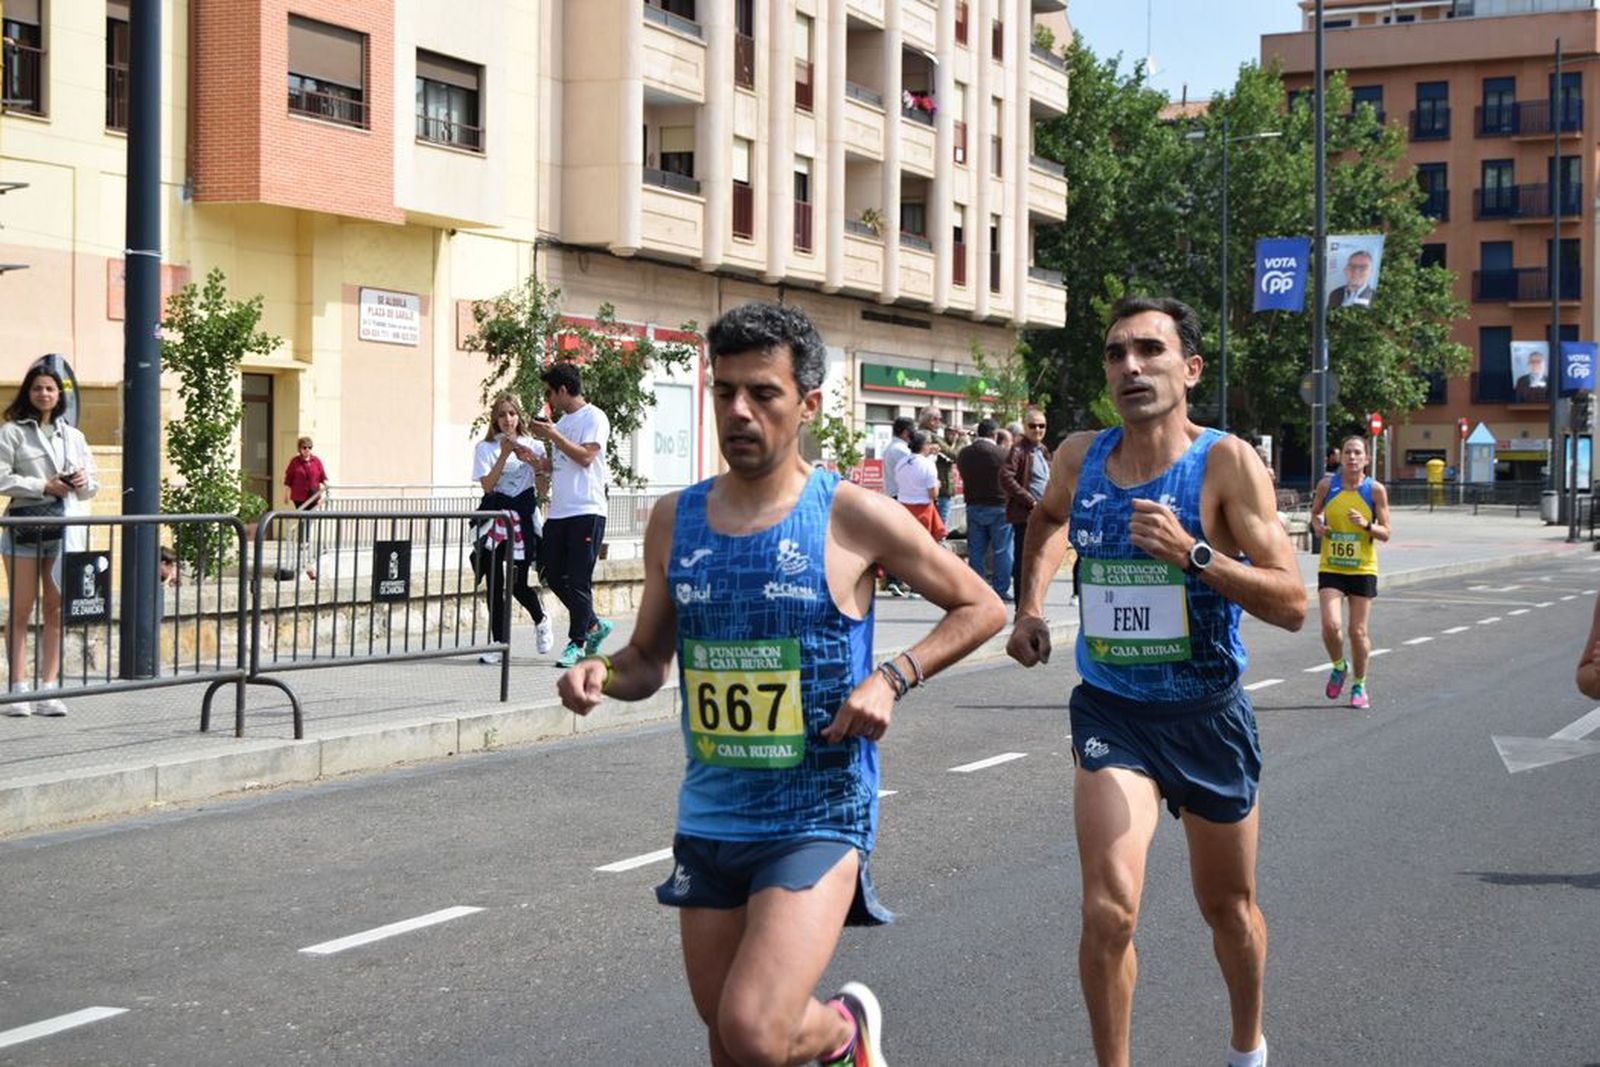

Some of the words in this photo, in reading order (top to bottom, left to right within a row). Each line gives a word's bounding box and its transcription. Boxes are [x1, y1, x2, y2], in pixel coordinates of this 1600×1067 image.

[1264, 257, 1297, 269] VOTA
[1567, 354, 1591, 362] VOTA
[1331, 543, 1354, 557] 166
[1107, 575, 1132, 584] CAJA
[1134, 575, 1169, 584] RURAL
[1113, 607, 1150, 632] FENI
[1110, 646, 1139, 657] CAJA
[1141, 644, 1184, 656] RURAL
[710, 659, 738, 669] CAJA
[740, 659, 782, 669] RURAL
[698, 682, 788, 732] 667
[717, 744, 747, 758] CAJA
[749, 744, 798, 758] RURAL
